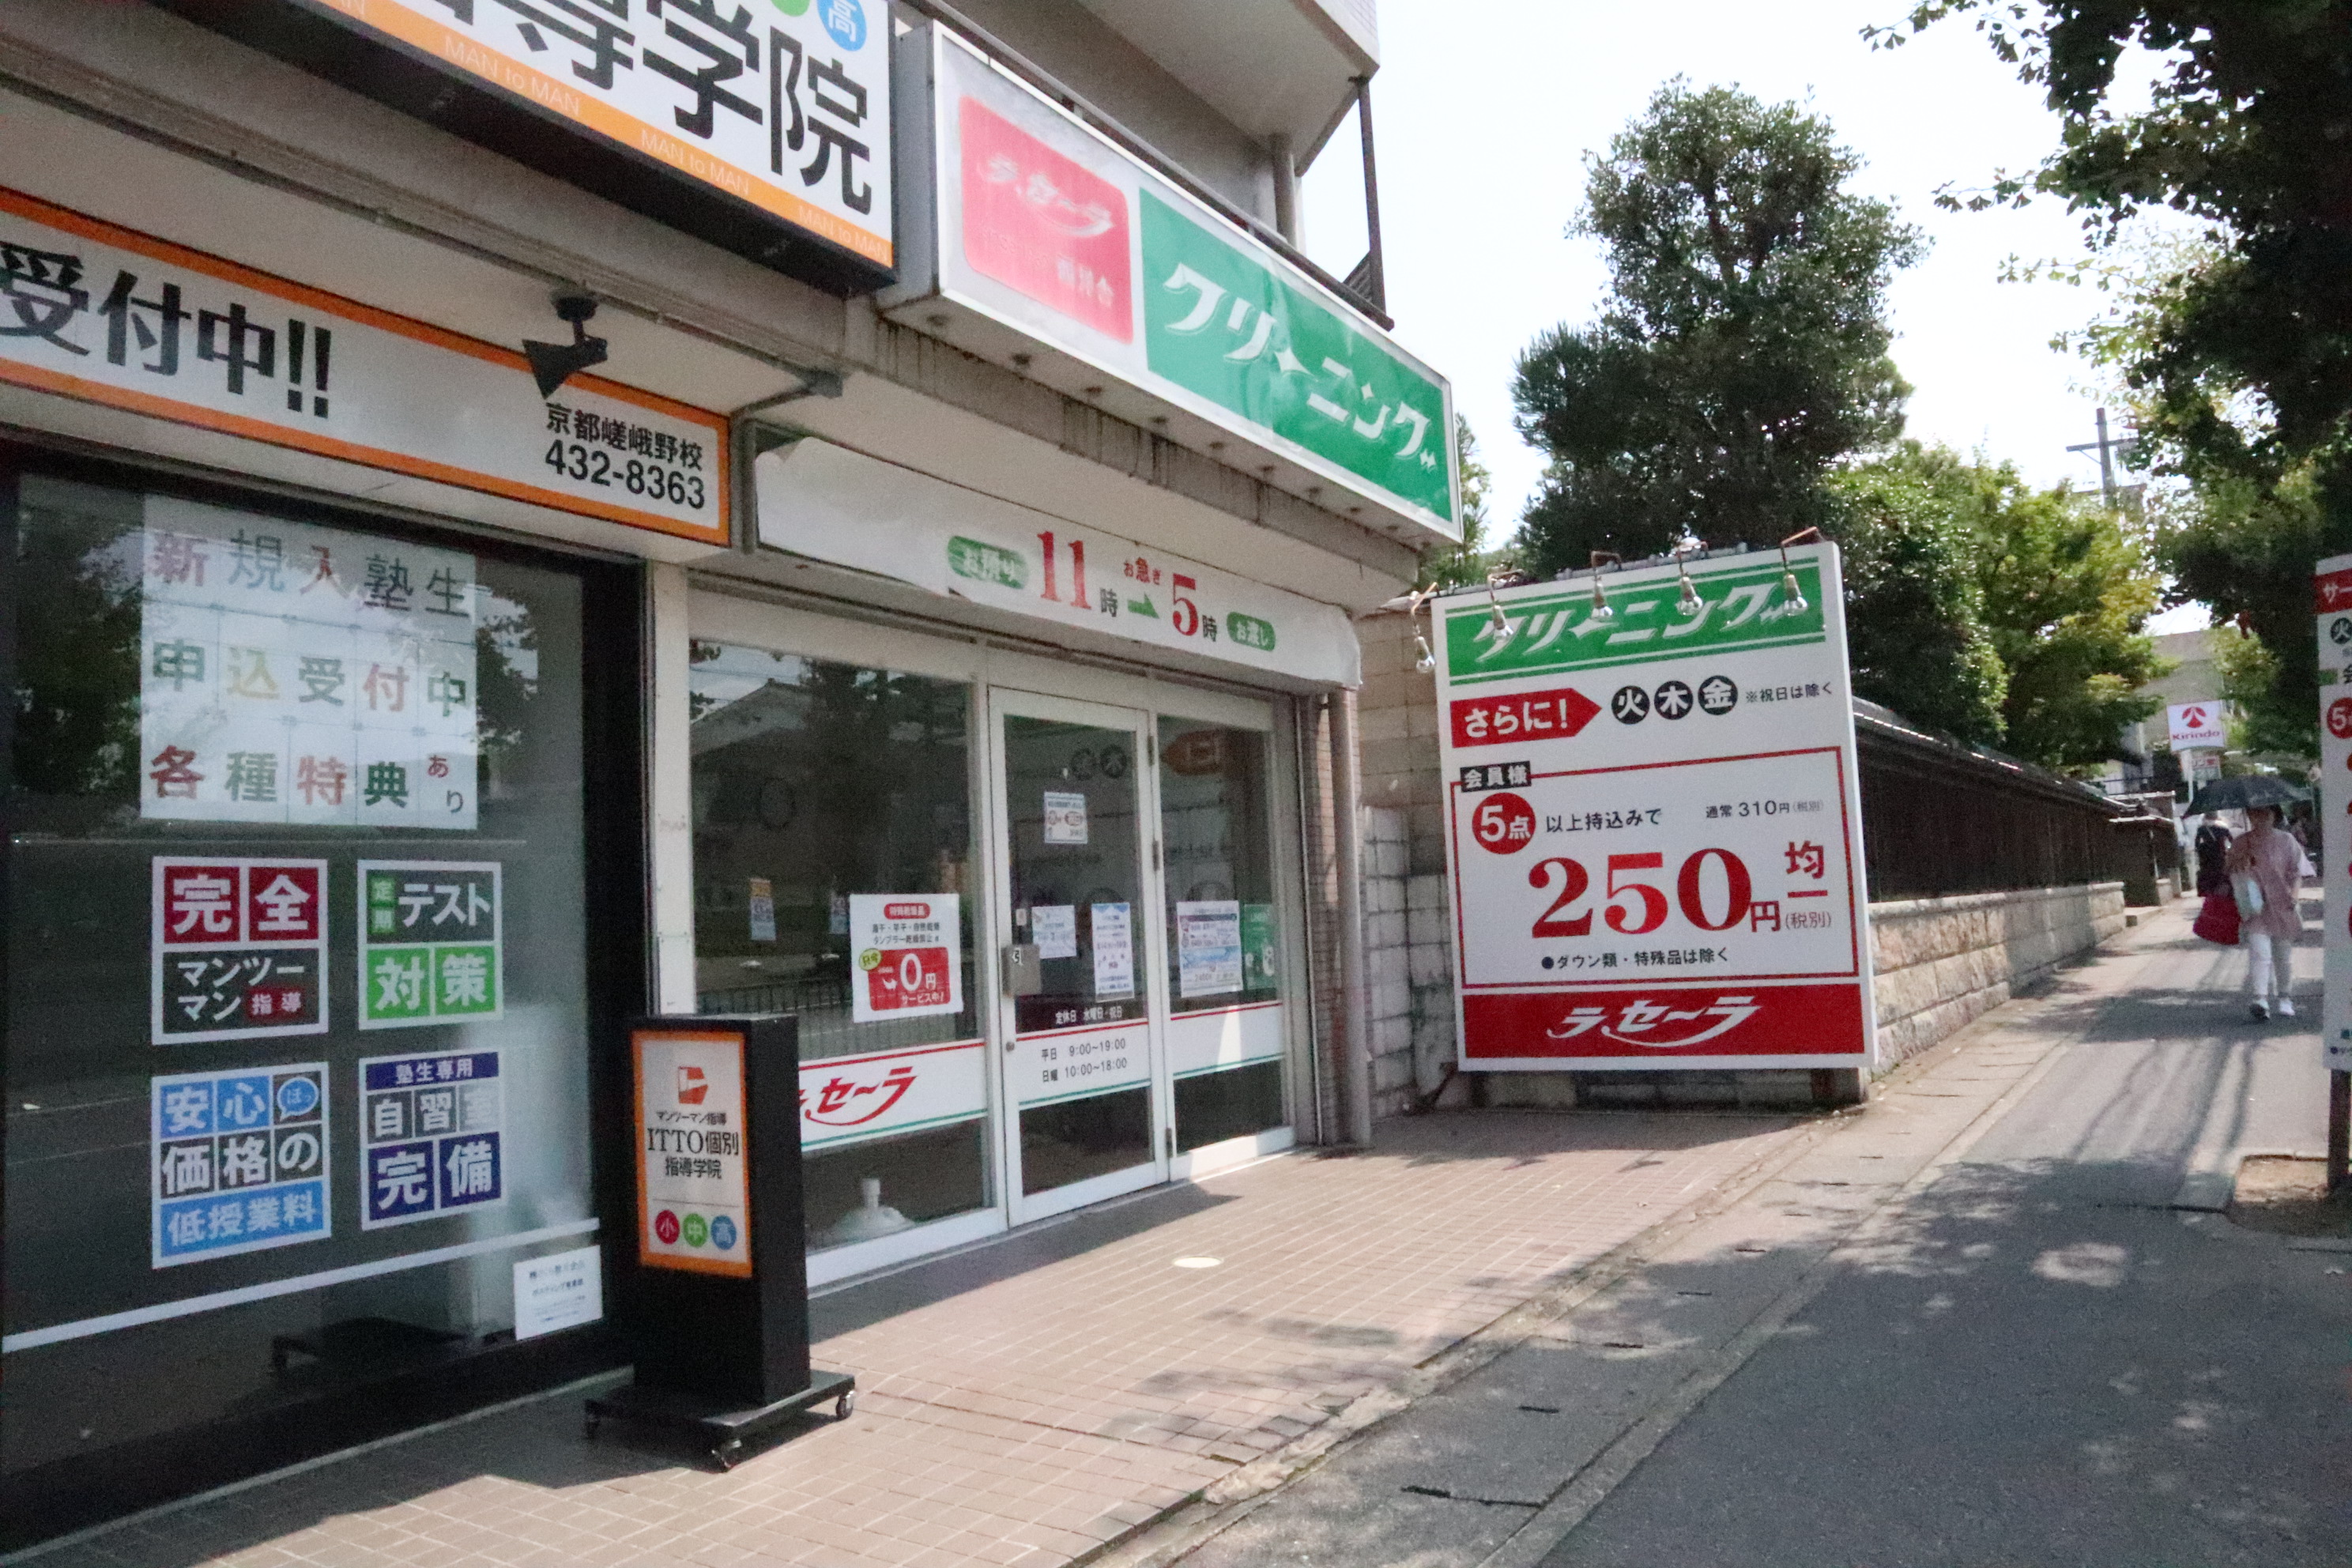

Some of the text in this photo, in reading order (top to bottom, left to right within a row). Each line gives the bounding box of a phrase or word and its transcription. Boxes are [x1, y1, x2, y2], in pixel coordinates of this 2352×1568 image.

[445, 36, 498, 78] MAN
[507, 68, 525, 89] to
[531, 77, 580, 116] MAN
[641, 130, 683, 164] MAN
[690, 156, 705, 173] to
[710, 167, 749, 196] MAN
[799, 205, 834, 237] MAN
[855, 236, 888, 262] MAN
[1163, 262, 1438, 473] クリーニング
[545, 401, 703, 472] 京都嵯峨野校
[545, 439, 705, 509] 432-8363
[151, 528, 471, 619] 新規入塾生
[1123, 556, 1162, 586] お急ぎ
[1235, 620, 1268, 646] お渡し
[152, 639, 467, 718] 申込受付中
[1464, 699, 1568, 738] さらに!
[2173, 729, 2220, 741] Kirindo
[1464, 765, 1529, 789] 会員様
[1479, 804, 1663, 842] 5点 以上持込みで
[1706, 805, 1733, 819] 通常
[172, 874, 311, 935] 完全
[398, 883, 492, 927] テスト
[177, 957, 305, 987] マンツー
[375, 953, 488, 1012] 対策
[1546, 995, 1763, 1048] ラセーラ
[396, 1057, 473, 1085] 塾生専用
[1042, 1047, 1057, 1061] 平日
[1042, 1069, 1058, 1083] 日曜
[165, 1081, 266, 1133] 安心
[287, 1087, 312, 1105] ほっ
[375, 1089, 496, 1139] 自習室
[799, 1066, 917, 1126] セーラ
[162, 1132, 320, 1195] 価格の
[647, 1127, 739, 1156] ITTO個別
[377, 1140, 493, 1211] 完備
[665, 1156, 722, 1180] 指導学院
[167, 1189, 315, 1247] 低授業料
